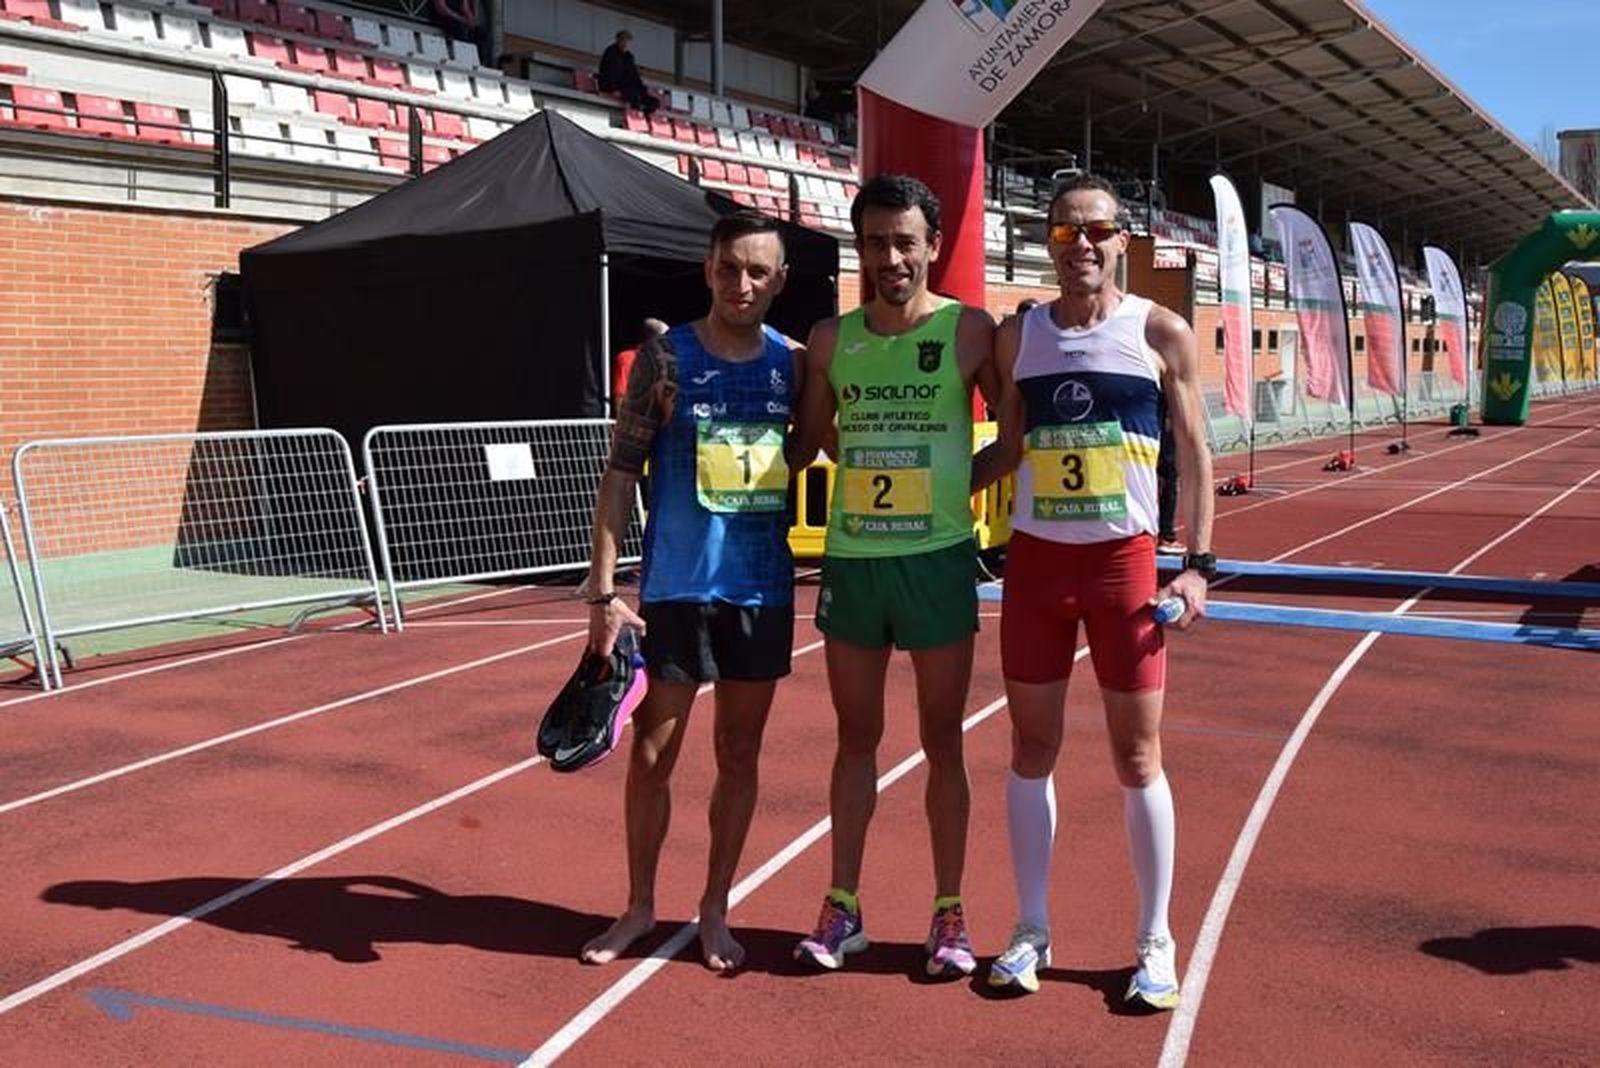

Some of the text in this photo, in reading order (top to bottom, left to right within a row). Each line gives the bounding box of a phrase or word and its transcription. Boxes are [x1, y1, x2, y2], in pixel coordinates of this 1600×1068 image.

[979, 65, 1008, 93] DE
[736, 450, 751, 485] 1
[1061, 454, 1085, 491] 3
[873, 474, 893, 509] 2
